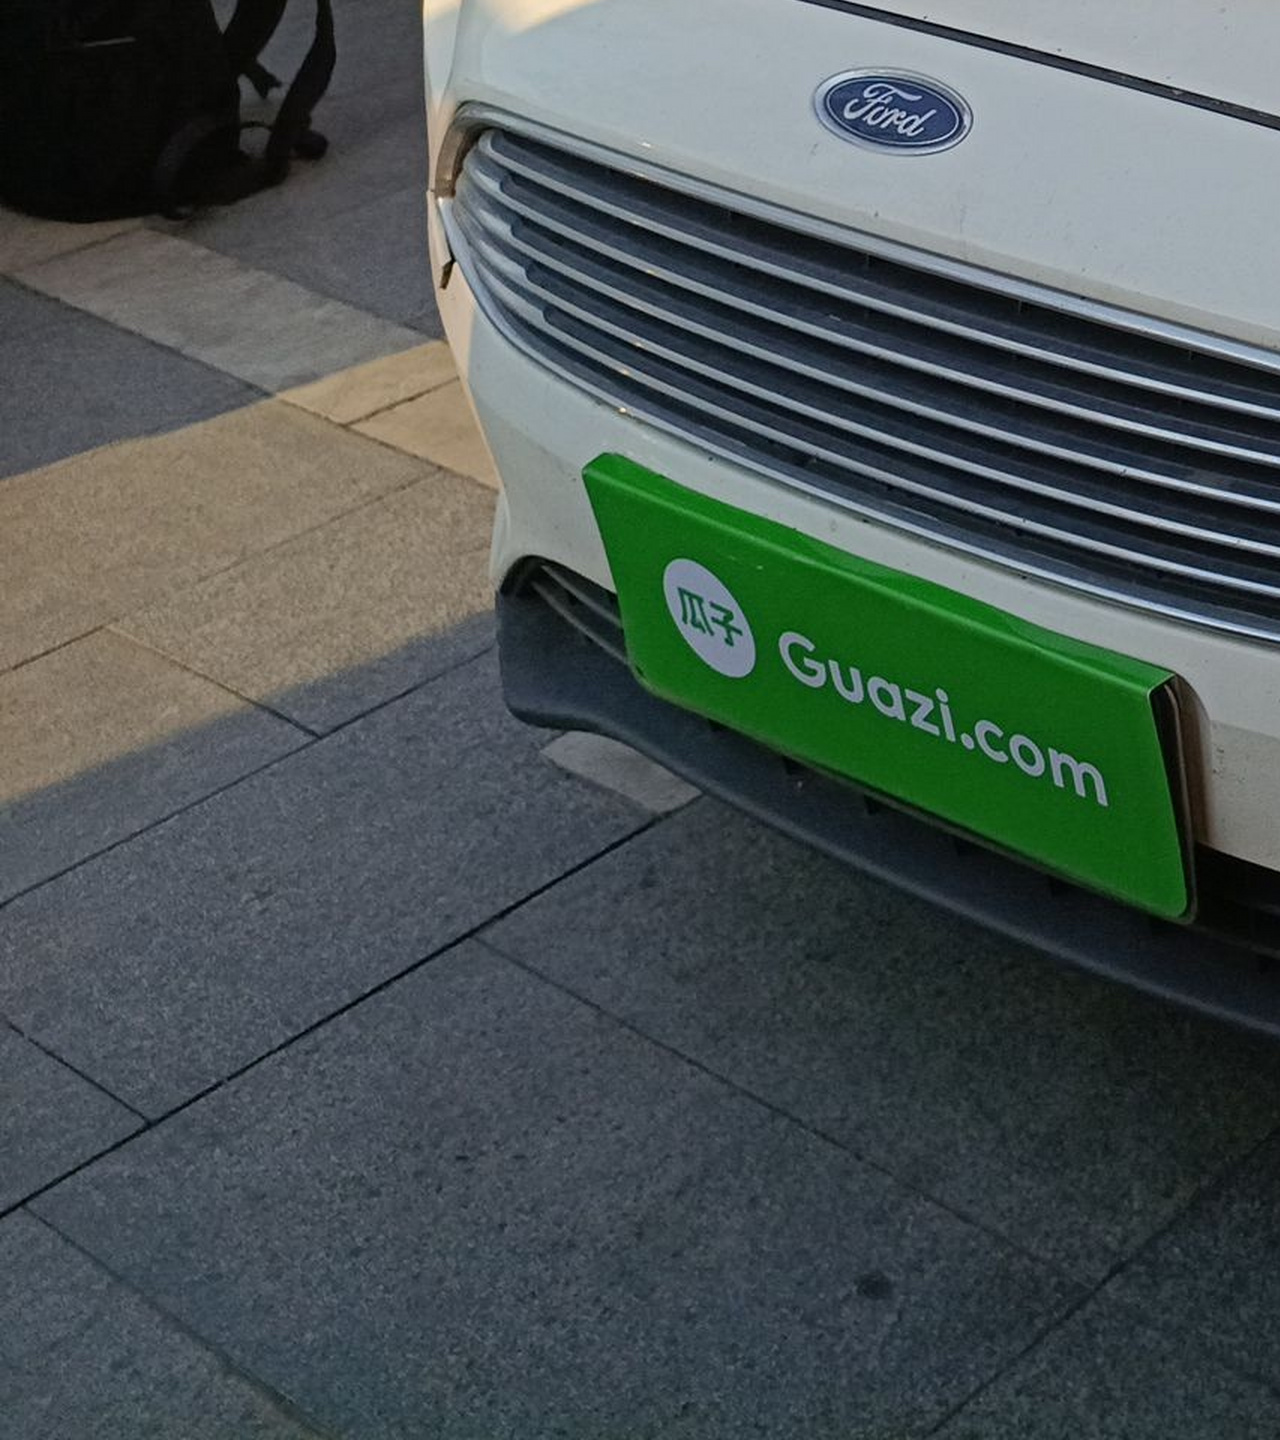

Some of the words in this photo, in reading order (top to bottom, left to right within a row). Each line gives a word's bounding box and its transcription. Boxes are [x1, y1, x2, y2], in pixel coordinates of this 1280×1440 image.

[843, 82, 937, 137] Ford
[677, 586, 744, 648] 瓜子
[777, 630, 1110, 807] Guazi.com
